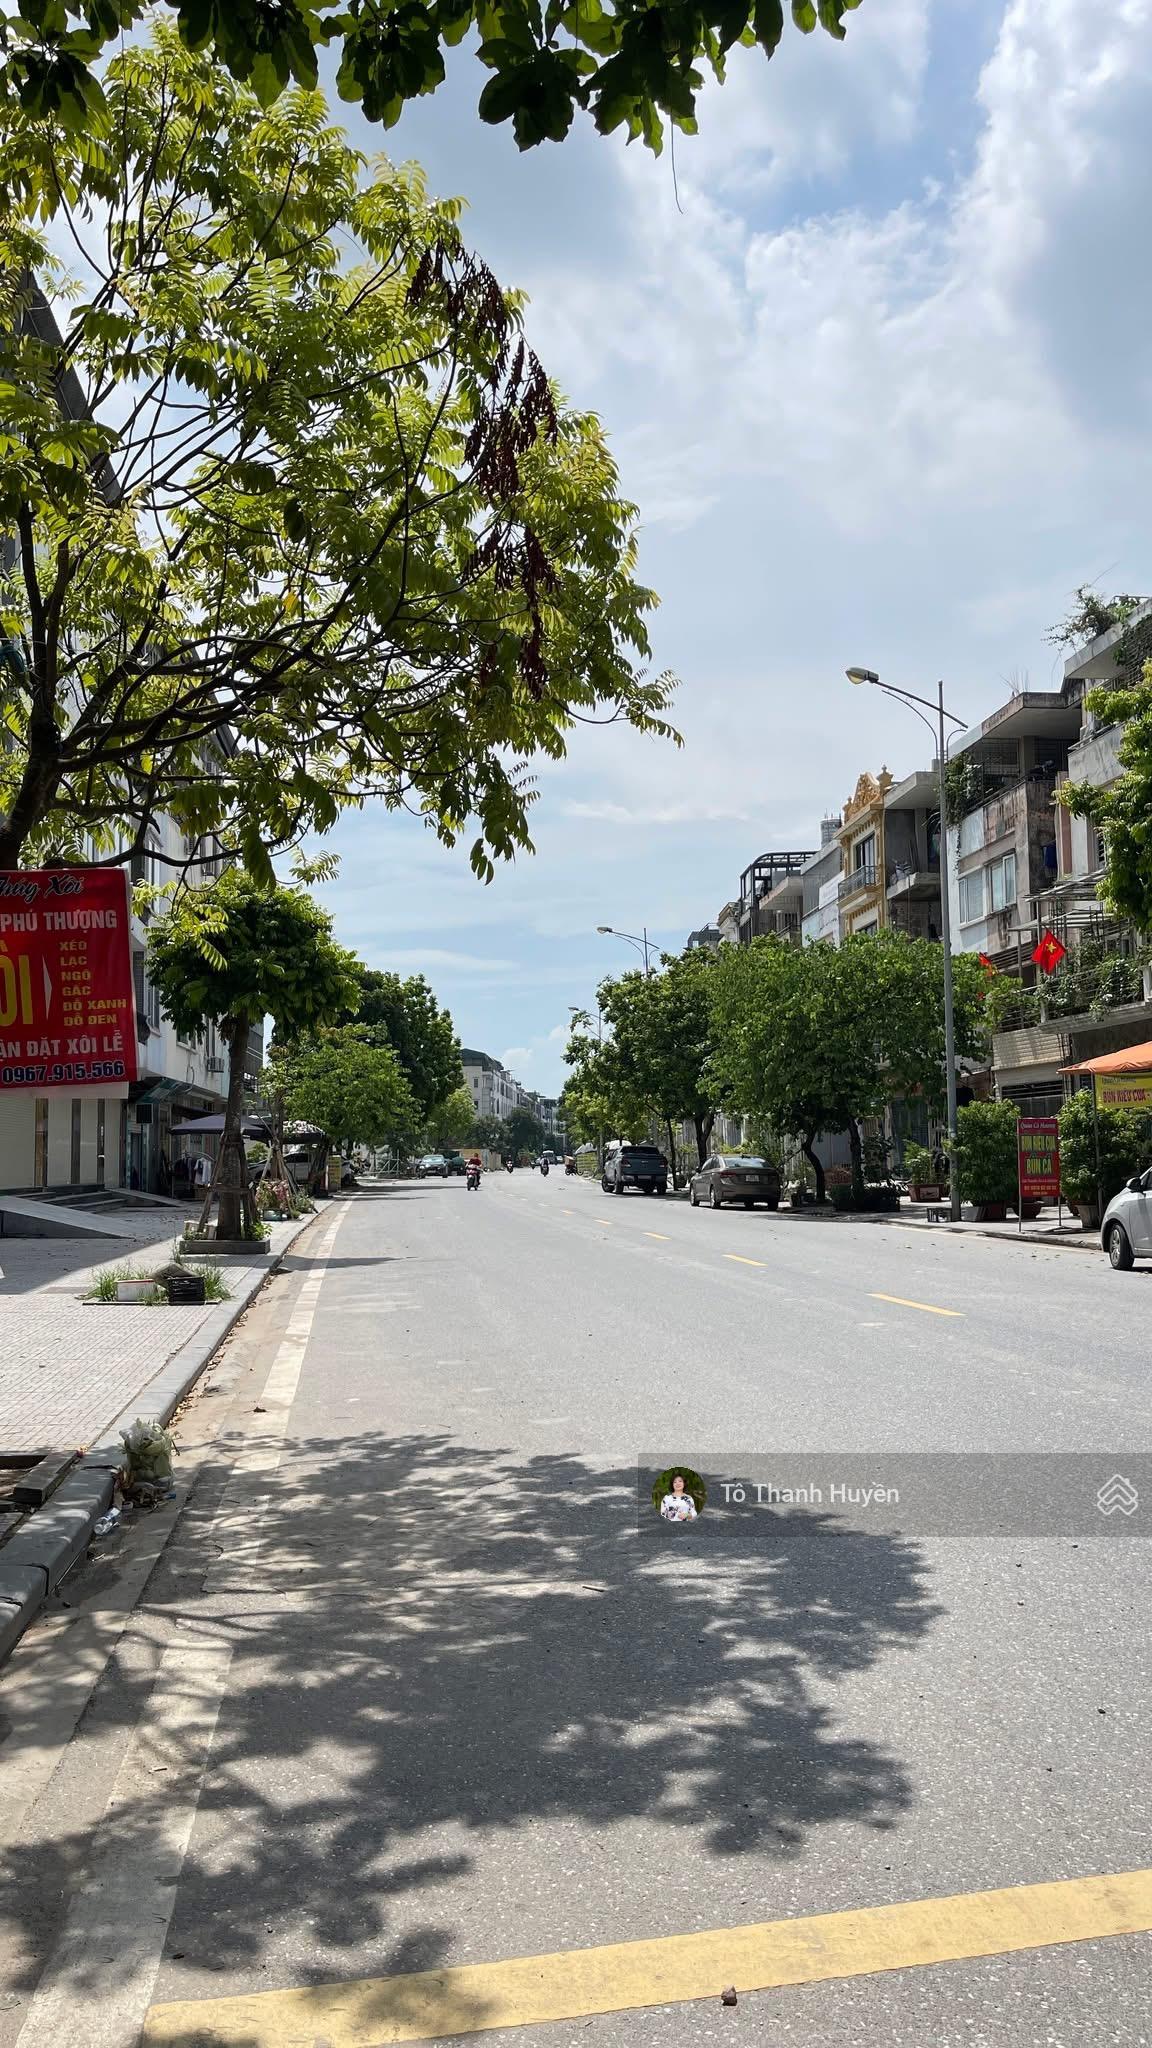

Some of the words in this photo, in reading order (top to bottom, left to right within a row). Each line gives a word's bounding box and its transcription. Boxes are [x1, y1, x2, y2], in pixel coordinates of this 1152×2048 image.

[0, 909, 38, 932] PHÚ
[43, 909, 117, 933] THƯỢNG
[88, 999, 127, 1010] XANH
[88, 1014, 117, 1025] ĐEN
[26, 1037, 60, 1059] ĐẶT
[67, 1035, 97, 1054] XÔI
[103, 1030, 124, 1052] LỄ
[2, 1060, 125, 1084] 0967.915.566
